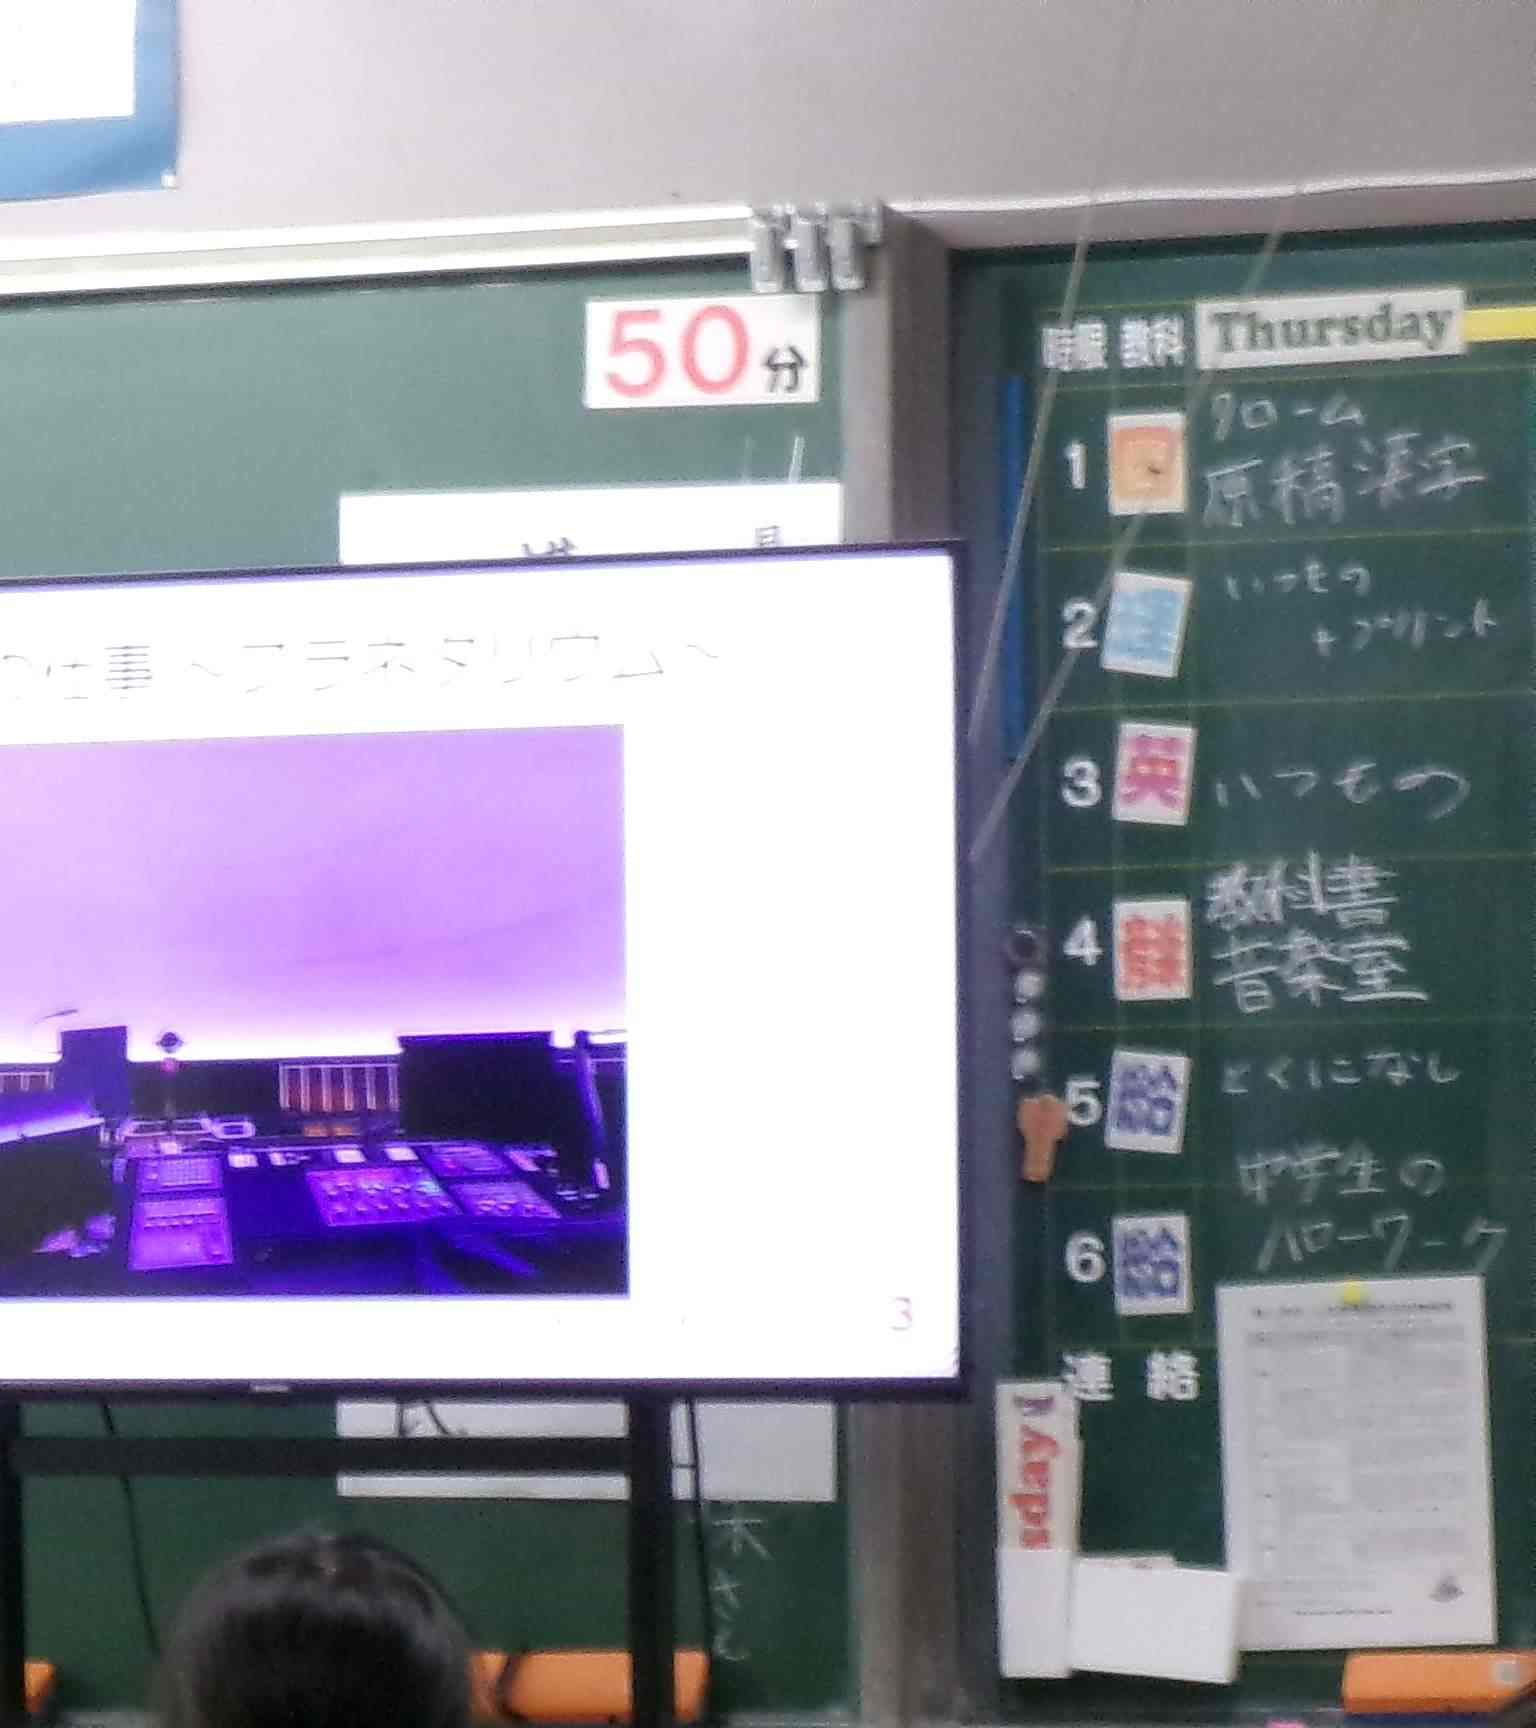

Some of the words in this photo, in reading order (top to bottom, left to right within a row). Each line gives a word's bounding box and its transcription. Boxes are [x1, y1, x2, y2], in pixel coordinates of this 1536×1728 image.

[605, 304, 808, 397] 50分
[1210, 303, 1455, 355] Thursday
[1063, 440, 1088, 490] 1
[1061, 601, 1098, 649] 2
[1061, 758, 1101, 808] 3
[1062, 913, 1105, 967] 4
[1064, 1079, 1104, 1128] 5
[1064, 1230, 1107, 1284] 6
